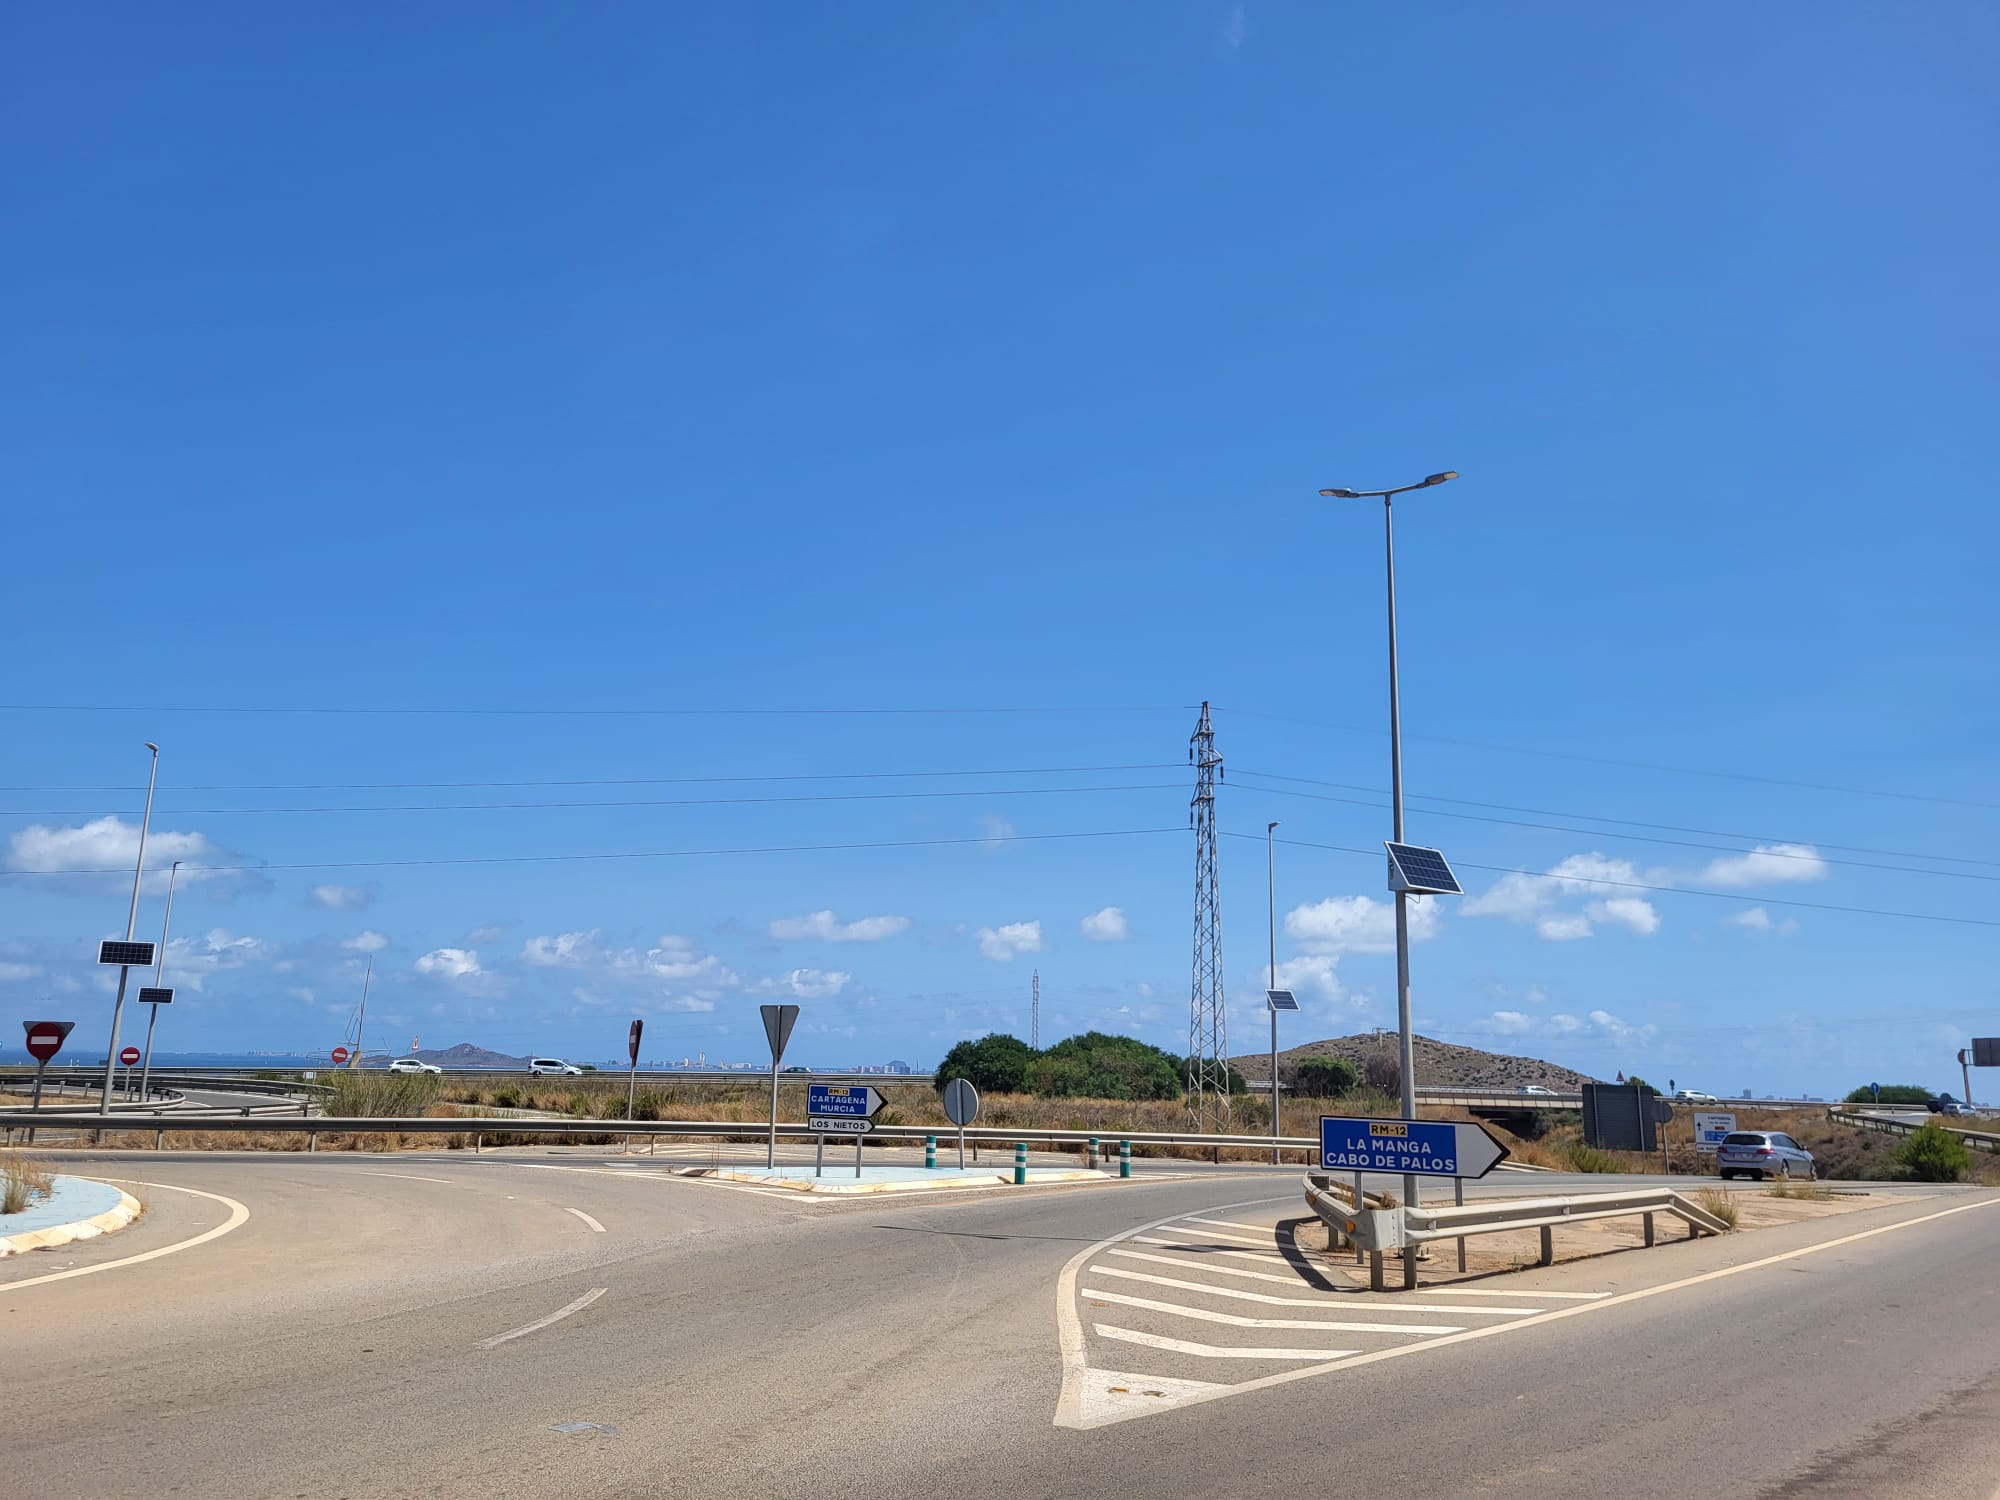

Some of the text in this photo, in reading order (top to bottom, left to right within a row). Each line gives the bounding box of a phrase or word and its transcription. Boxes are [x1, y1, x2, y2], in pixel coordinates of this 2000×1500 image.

[811, 1096, 865, 1104] CARTAGENA
[820, 1104, 854, 1112] MURCIA
[834, 1122, 865, 1130] NIETOS
[1370, 1124, 1406, 1136] RM-12
[1347, 1138, 1432, 1154] LA MANGA
[1326, 1152, 1455, 1170] CABO DE PALOS
